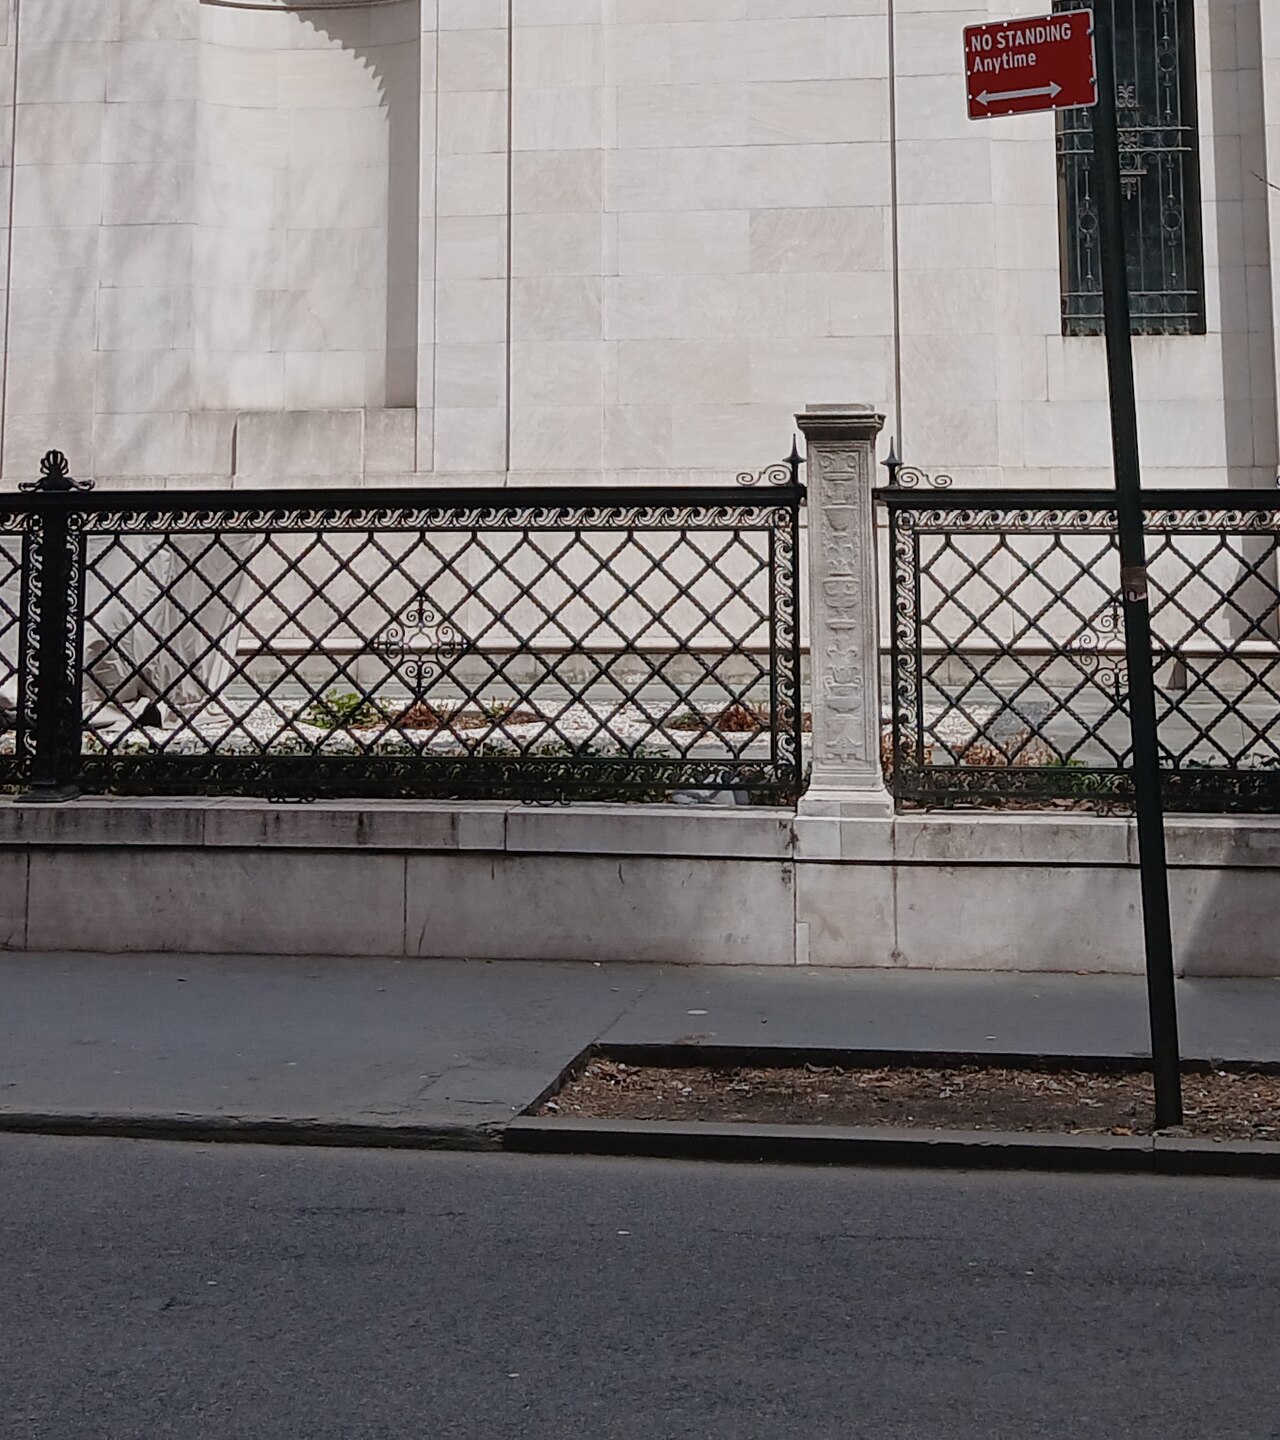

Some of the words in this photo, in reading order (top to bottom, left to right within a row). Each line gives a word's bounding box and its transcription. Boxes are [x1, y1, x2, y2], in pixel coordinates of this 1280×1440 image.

[971, 34, 992, 52] NO
[997, 23, 1072, 49] STANDING
[973, 51, 1037, 74] Anytime
